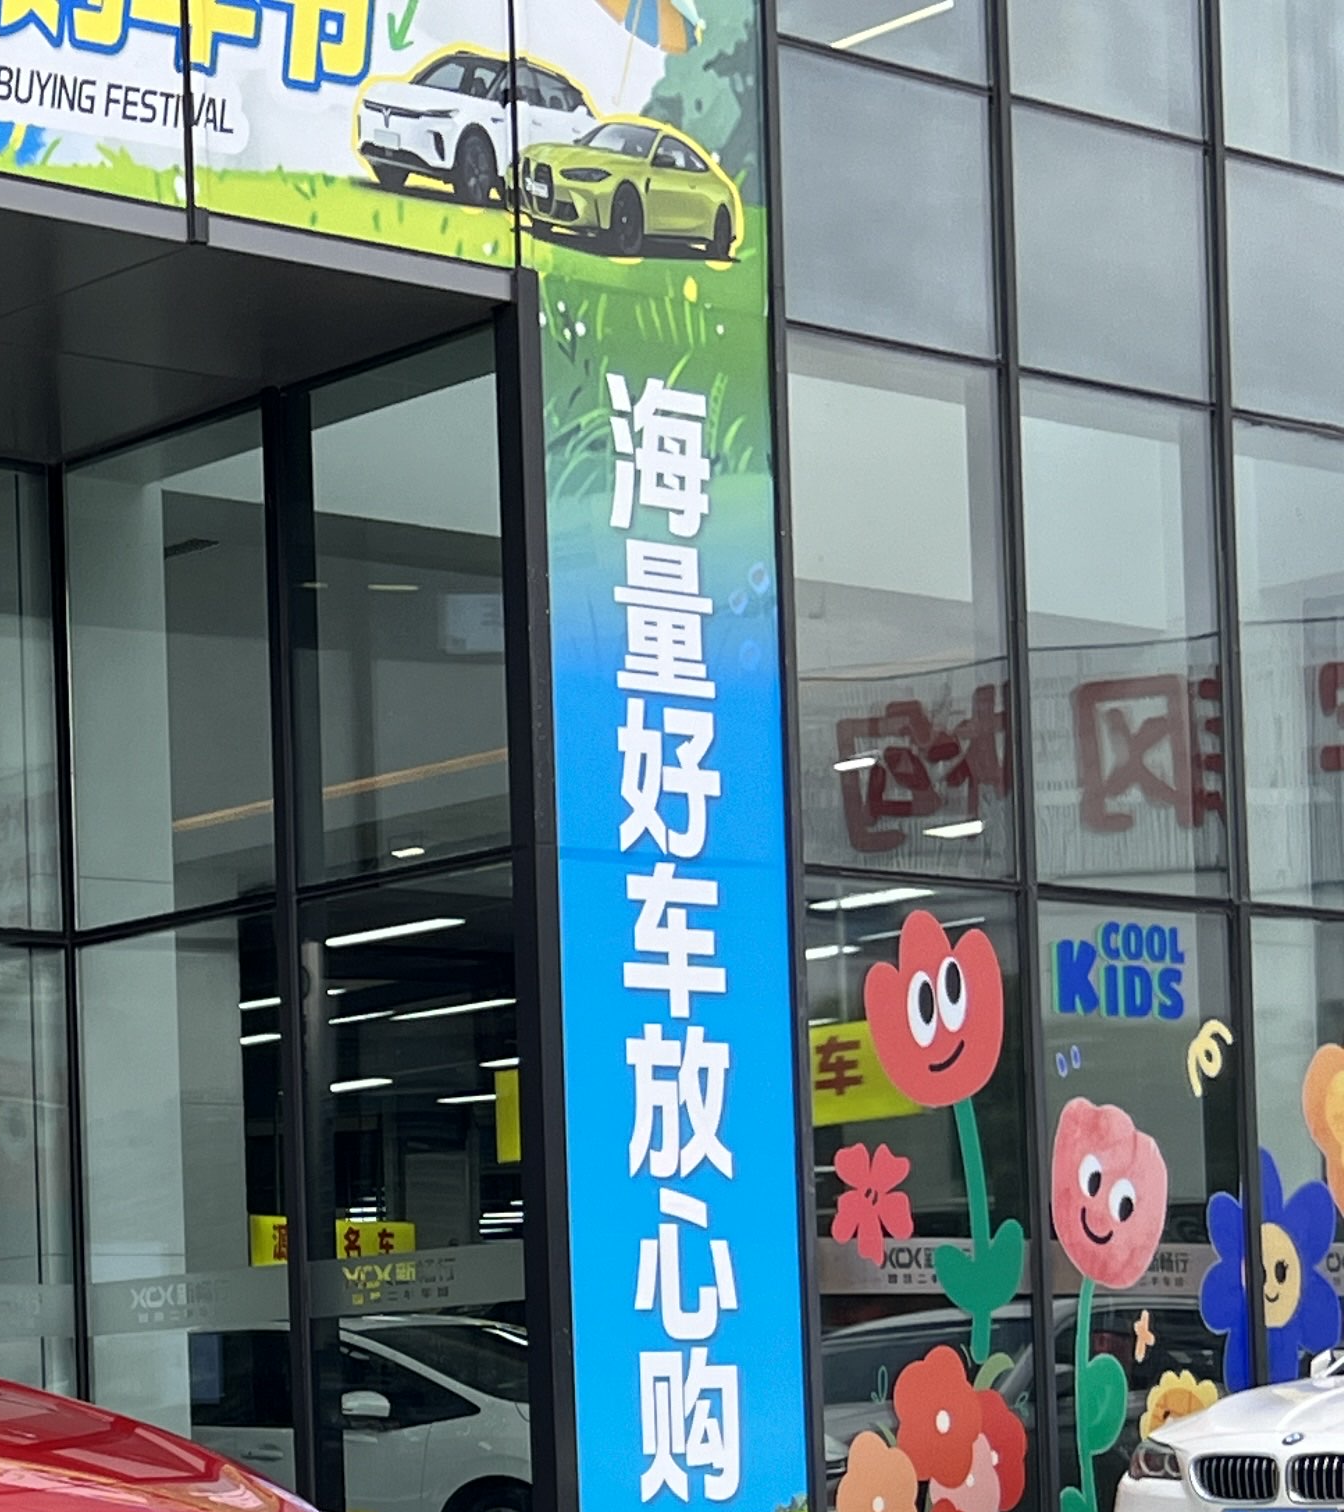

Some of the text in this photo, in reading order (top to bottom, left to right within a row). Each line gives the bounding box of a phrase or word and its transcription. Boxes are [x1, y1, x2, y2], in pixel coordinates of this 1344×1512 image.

[104, 83, 234, 135] FESTIVAL
[607, 371, 741, 1505] 海量好车放心购
[1099, 921, 1186, 964] COOL
[1052, 938, 1185, 1019] KIDS
[814, 1036, 863, 1096] 车
